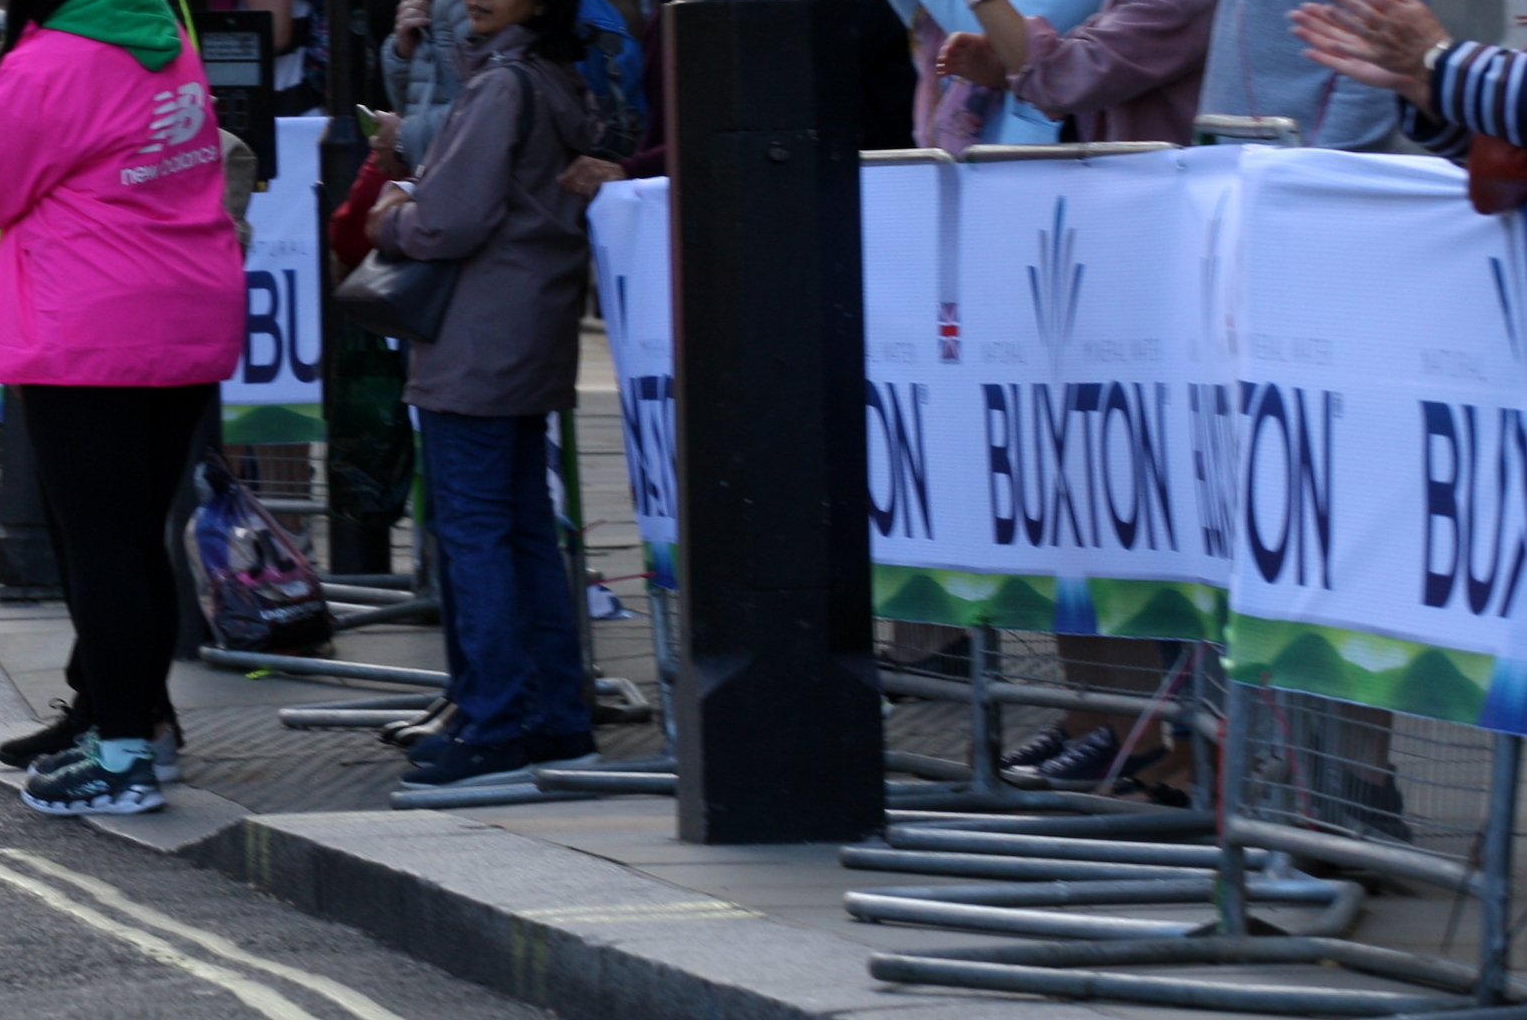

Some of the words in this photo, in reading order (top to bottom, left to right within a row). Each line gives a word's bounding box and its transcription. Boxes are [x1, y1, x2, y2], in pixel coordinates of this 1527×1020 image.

[120, 164, 159, 185] new
[160, 145, 218, 176] balance
[980, 380, 1180, 552] BUXTON
